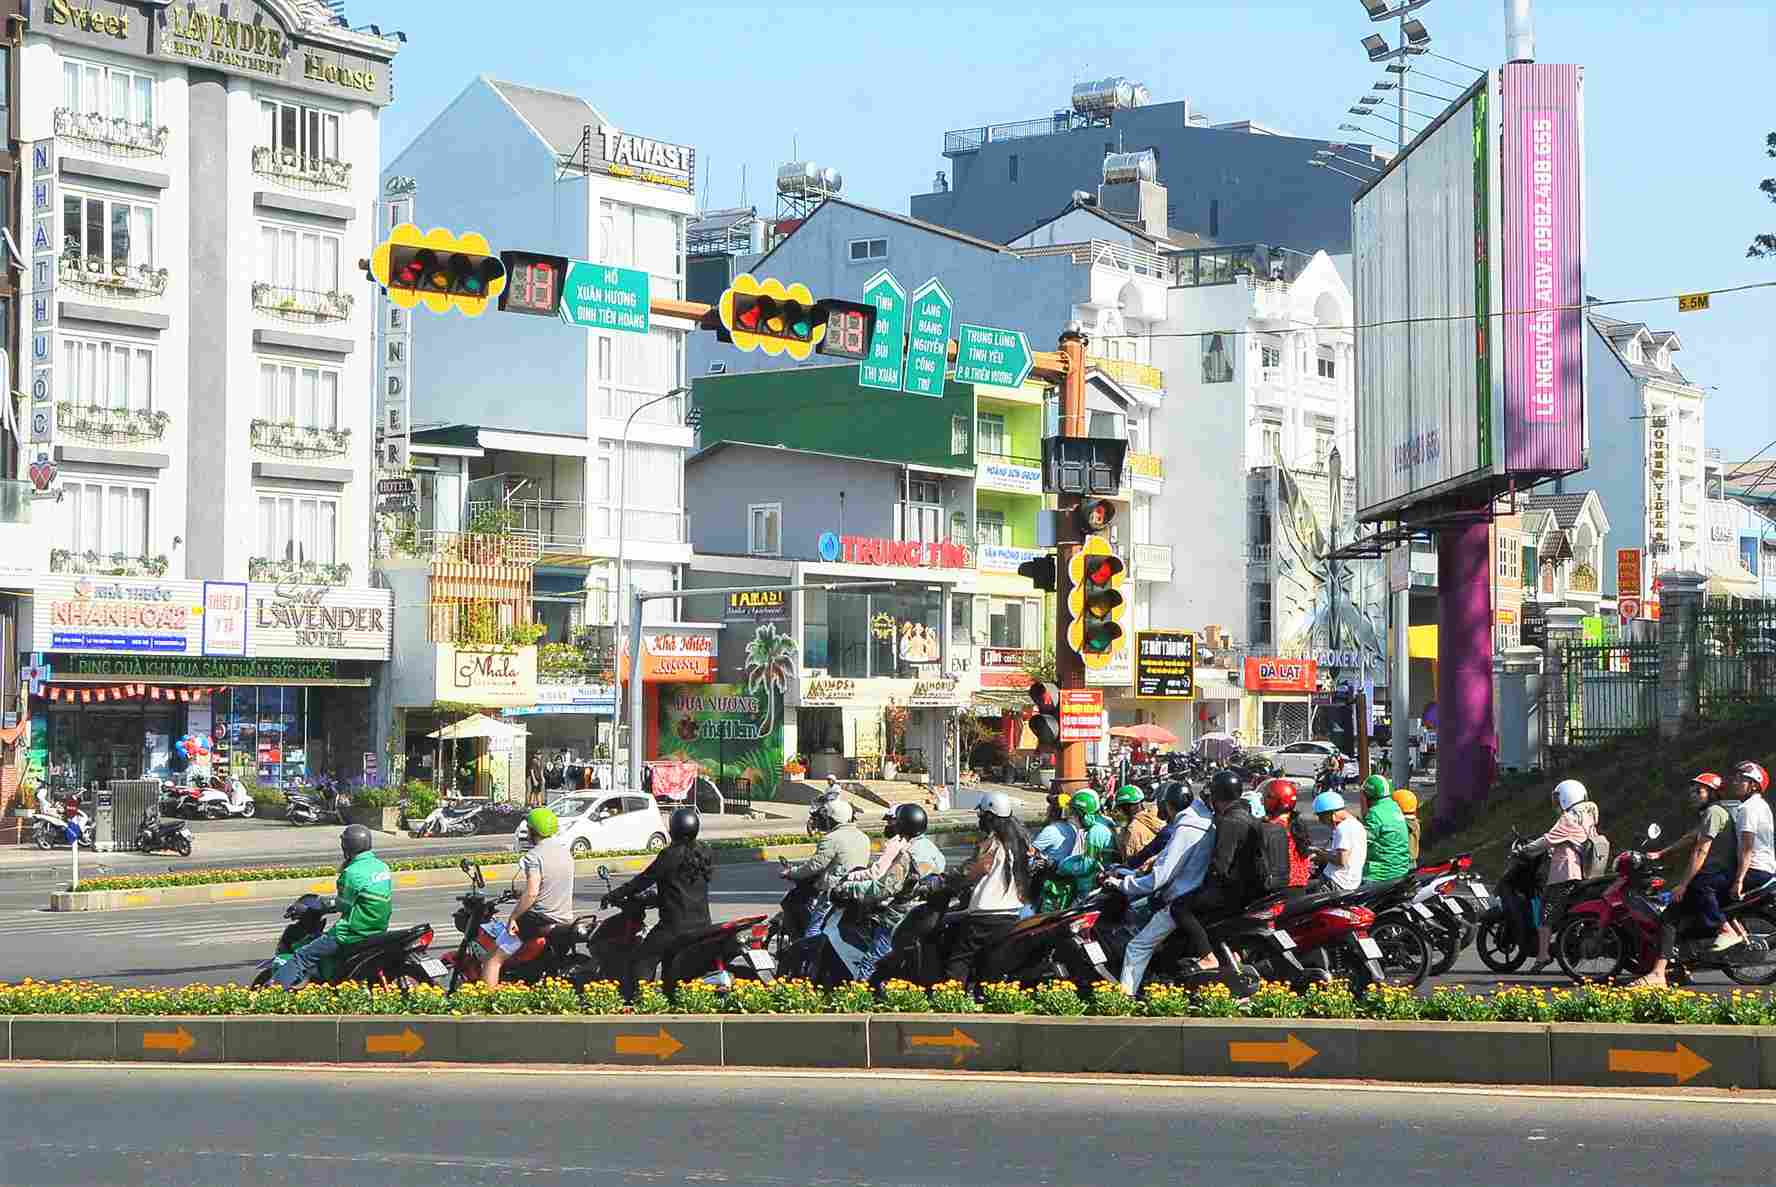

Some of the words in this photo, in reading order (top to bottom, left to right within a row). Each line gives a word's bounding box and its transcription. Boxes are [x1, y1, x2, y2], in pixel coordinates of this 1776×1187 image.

[173, 6, 282, 59] LAVENDER
[304, 52, 376, 92] House
[840, 534, 922, 567] TRUNG
[255, 598, 386, 634] LAVENDER
[295, 630, 348, 649] HOTEL
